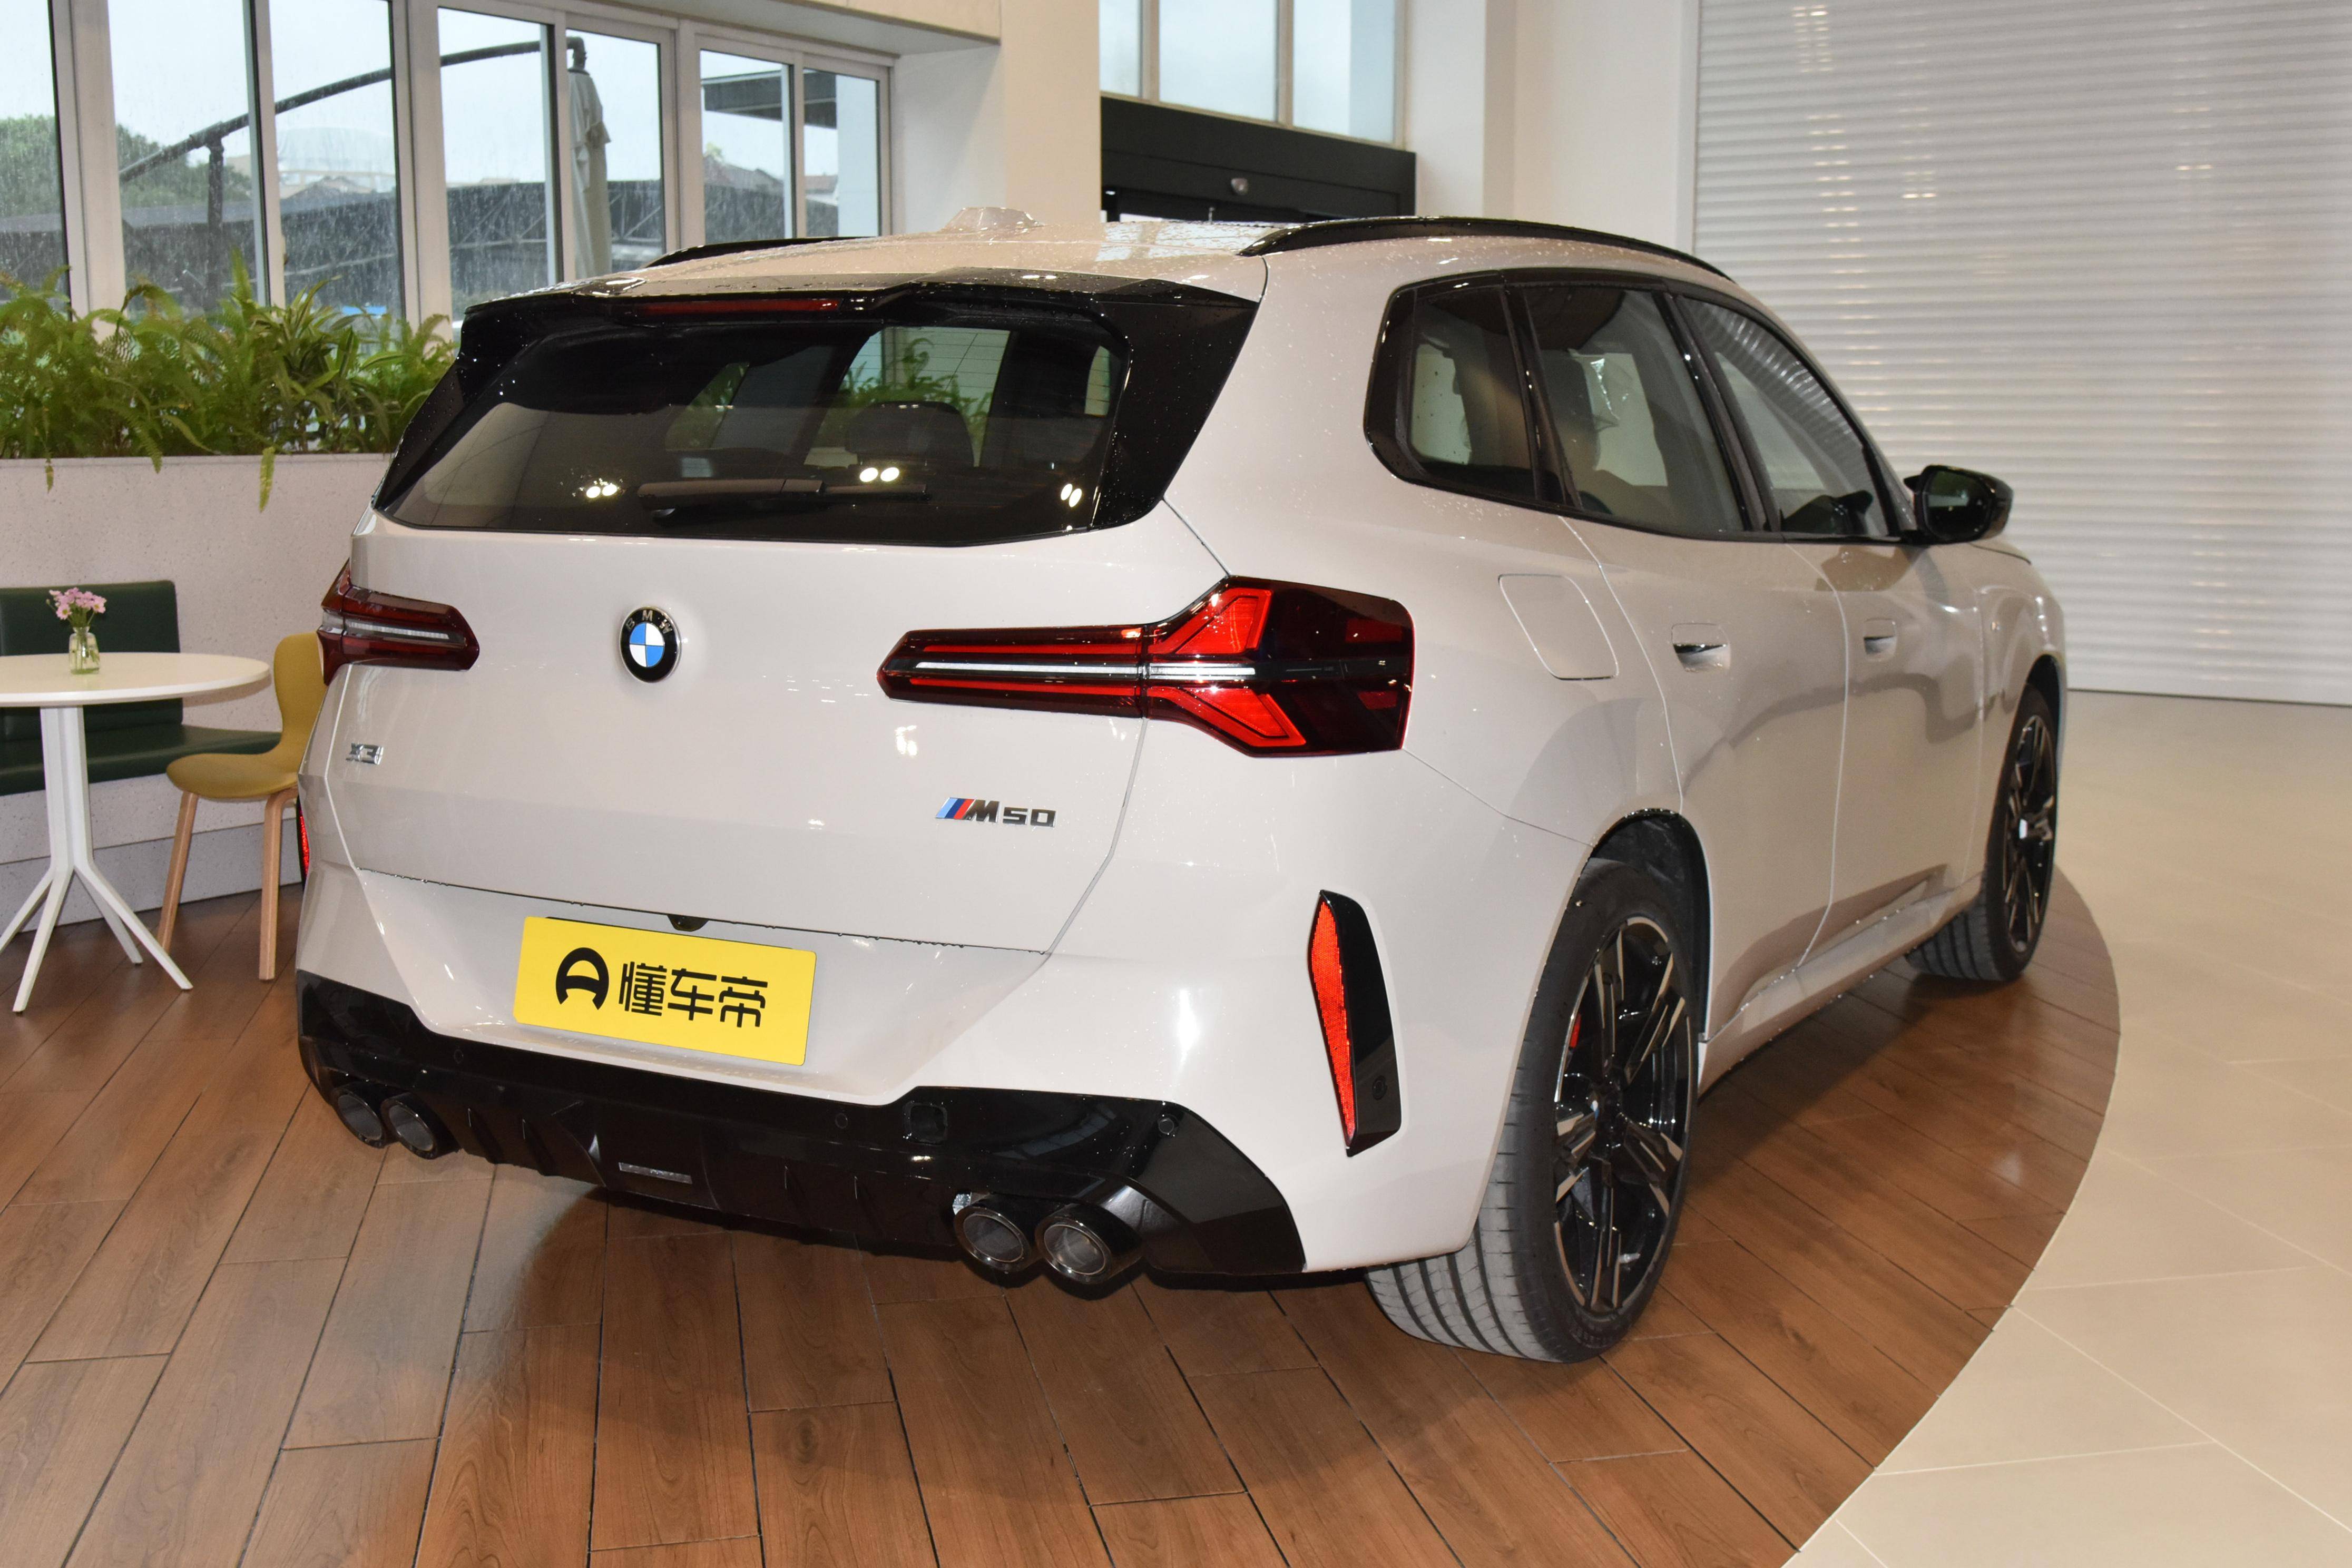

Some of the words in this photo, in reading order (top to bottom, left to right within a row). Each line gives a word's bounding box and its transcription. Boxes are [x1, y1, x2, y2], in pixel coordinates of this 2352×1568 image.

[626, 610, 673, 634] BMW
[962, 799, 1056, 827] M50
[618, 961, 768, 1028] 懂车帝
